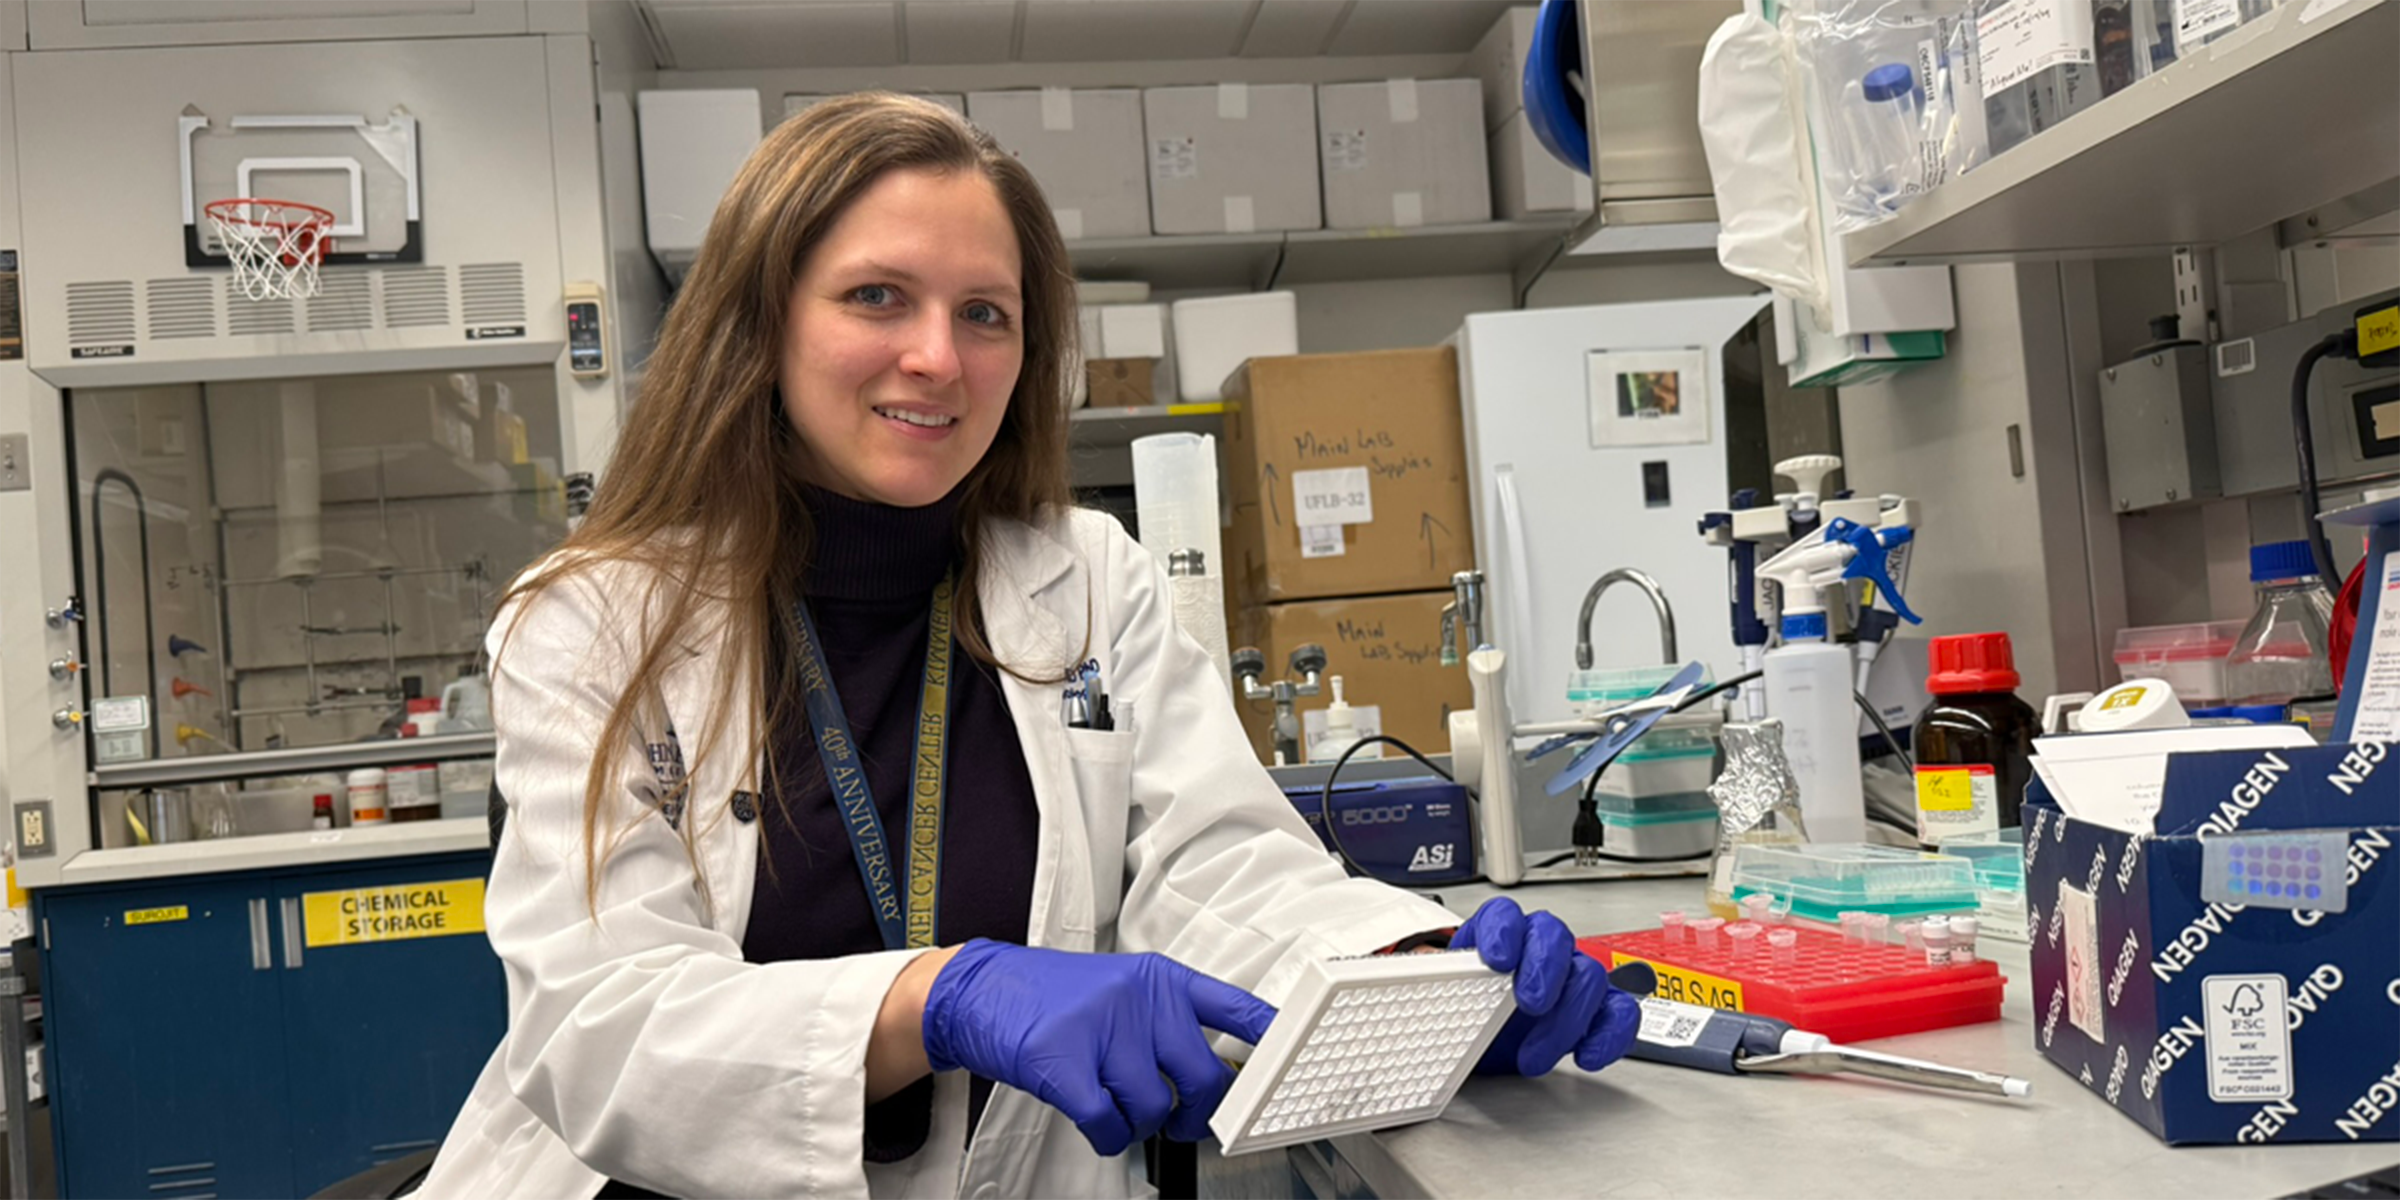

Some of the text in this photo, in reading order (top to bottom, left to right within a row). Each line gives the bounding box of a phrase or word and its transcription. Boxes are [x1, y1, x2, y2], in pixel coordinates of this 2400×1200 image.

[833, 766, 903, 922] ANNIVERSARY
[341, 890, 449, 915] CHEMICAL
[347, 912, 446, 936] STORAGE
[2107, 927, 2140, 1007] QIAGEN
[2042, 980, 2065, 1047] QIAGEN
[2231, 1018, 2265, 1030] FSC
[2140, 1015, 2205, 1101] QIAGEN
